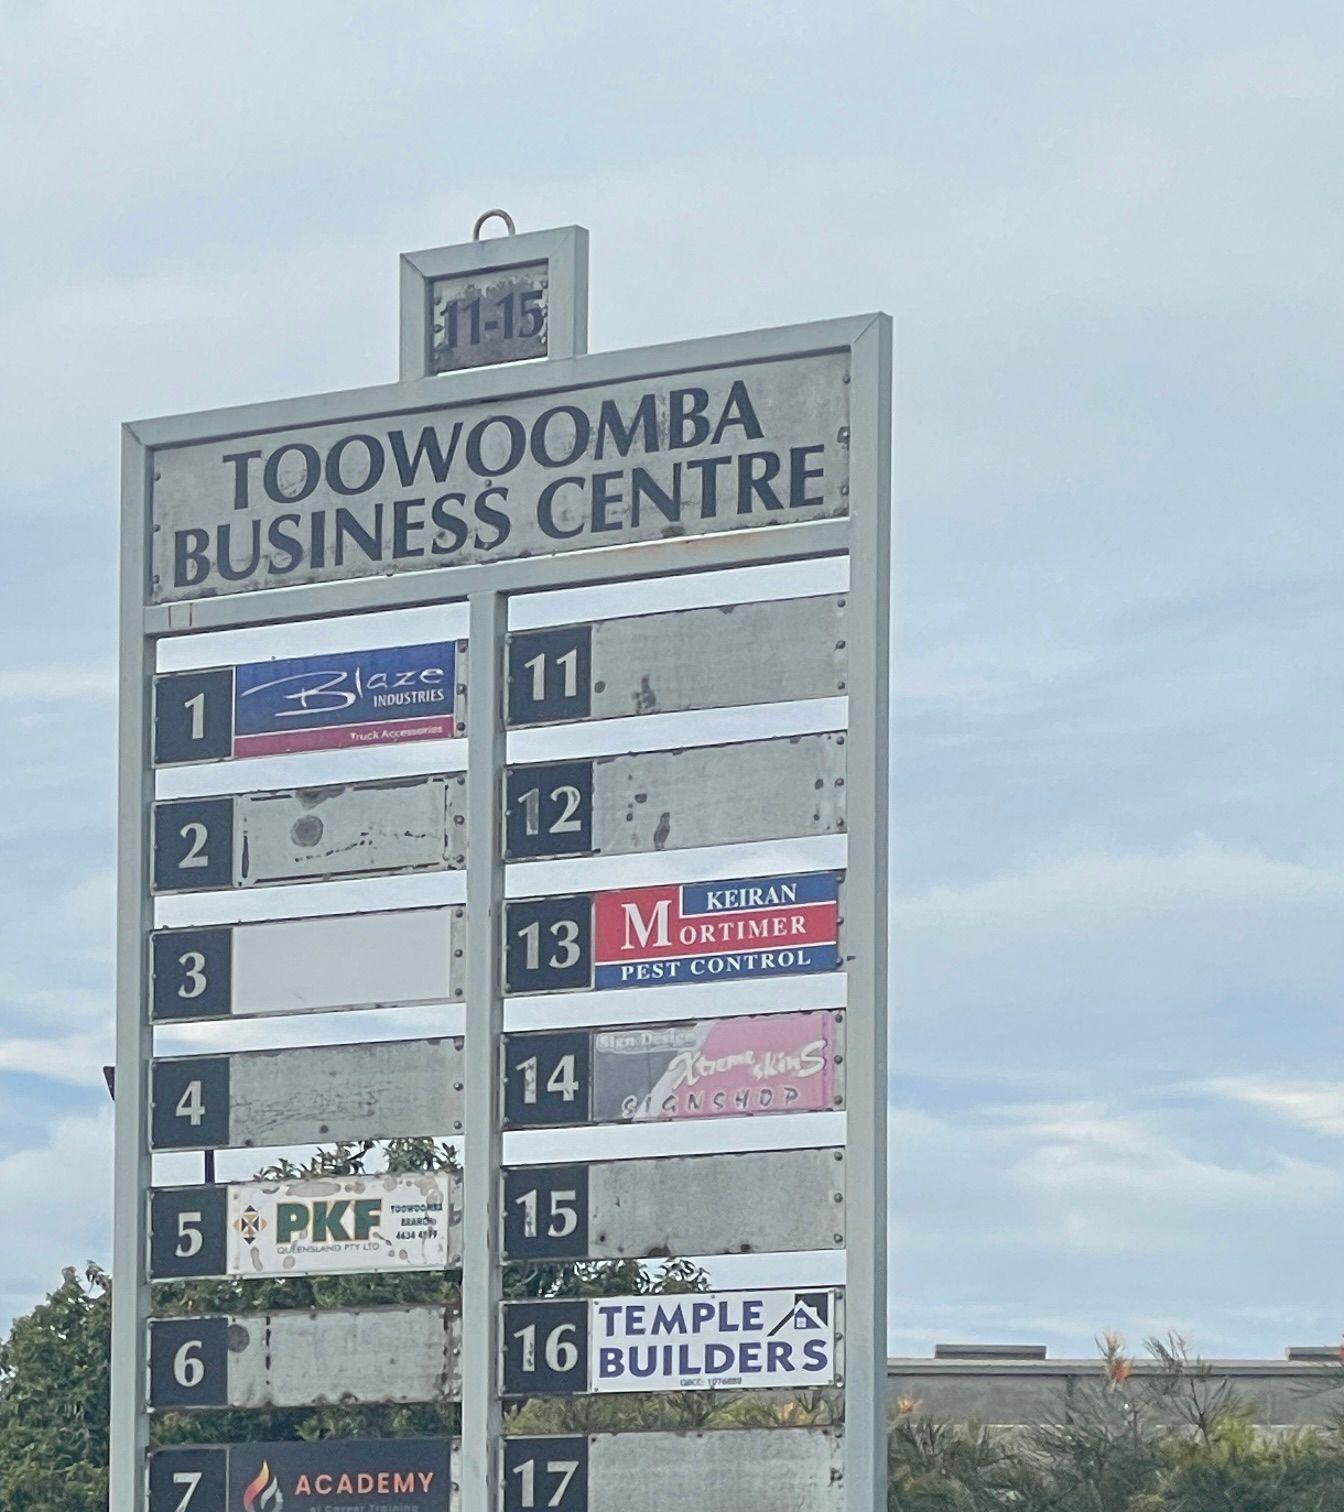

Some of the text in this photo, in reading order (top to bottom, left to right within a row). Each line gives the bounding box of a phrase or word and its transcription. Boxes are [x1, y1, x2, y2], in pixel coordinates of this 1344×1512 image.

[440, 290, 544, 349] 11-15
[222, 380, 764, 509] TOOWOOMBA
[173, 444, 824, 587] BUSINESS CENTRE
[241, 667, 444, 717] Blaze
[373, 688, 445, 708] INDUSTRIES
[524, 649, 577, 701] 11
[185, 693, 205, 739] 1
[350, 725, 443, 741] Truck Accessories
[518, 786, 581, 836] 12
[178, 823, 209, 869] 2
[706, 884, 797, 911] KEIRAN
[517, 900, 807, 970] 13 MORTIMER
[177, 952, 207, 999] 3
[621, 950, 812, 981] PEST CONTROL
[598, 1034, 635, 1050] Sign
[175, 1081, 206, 1126] 4
[515, 1055, 579, 1105] 14
[175, 1199, 382, 1258] 5 PKF
[515, 1188, 578, 1238] 15
[277, 1242, 380, 1255] QUEENSLAND PTY LTD
[514, 1300, 763, 1373] 16 TEMPLE
[599, 1339, 828, 1379] BUILDERS
[173, 1340, 205, 1387] 6
[294, 1471, 434, 1496] ACADEMY
[512, 1459, 580, 1508] 17
